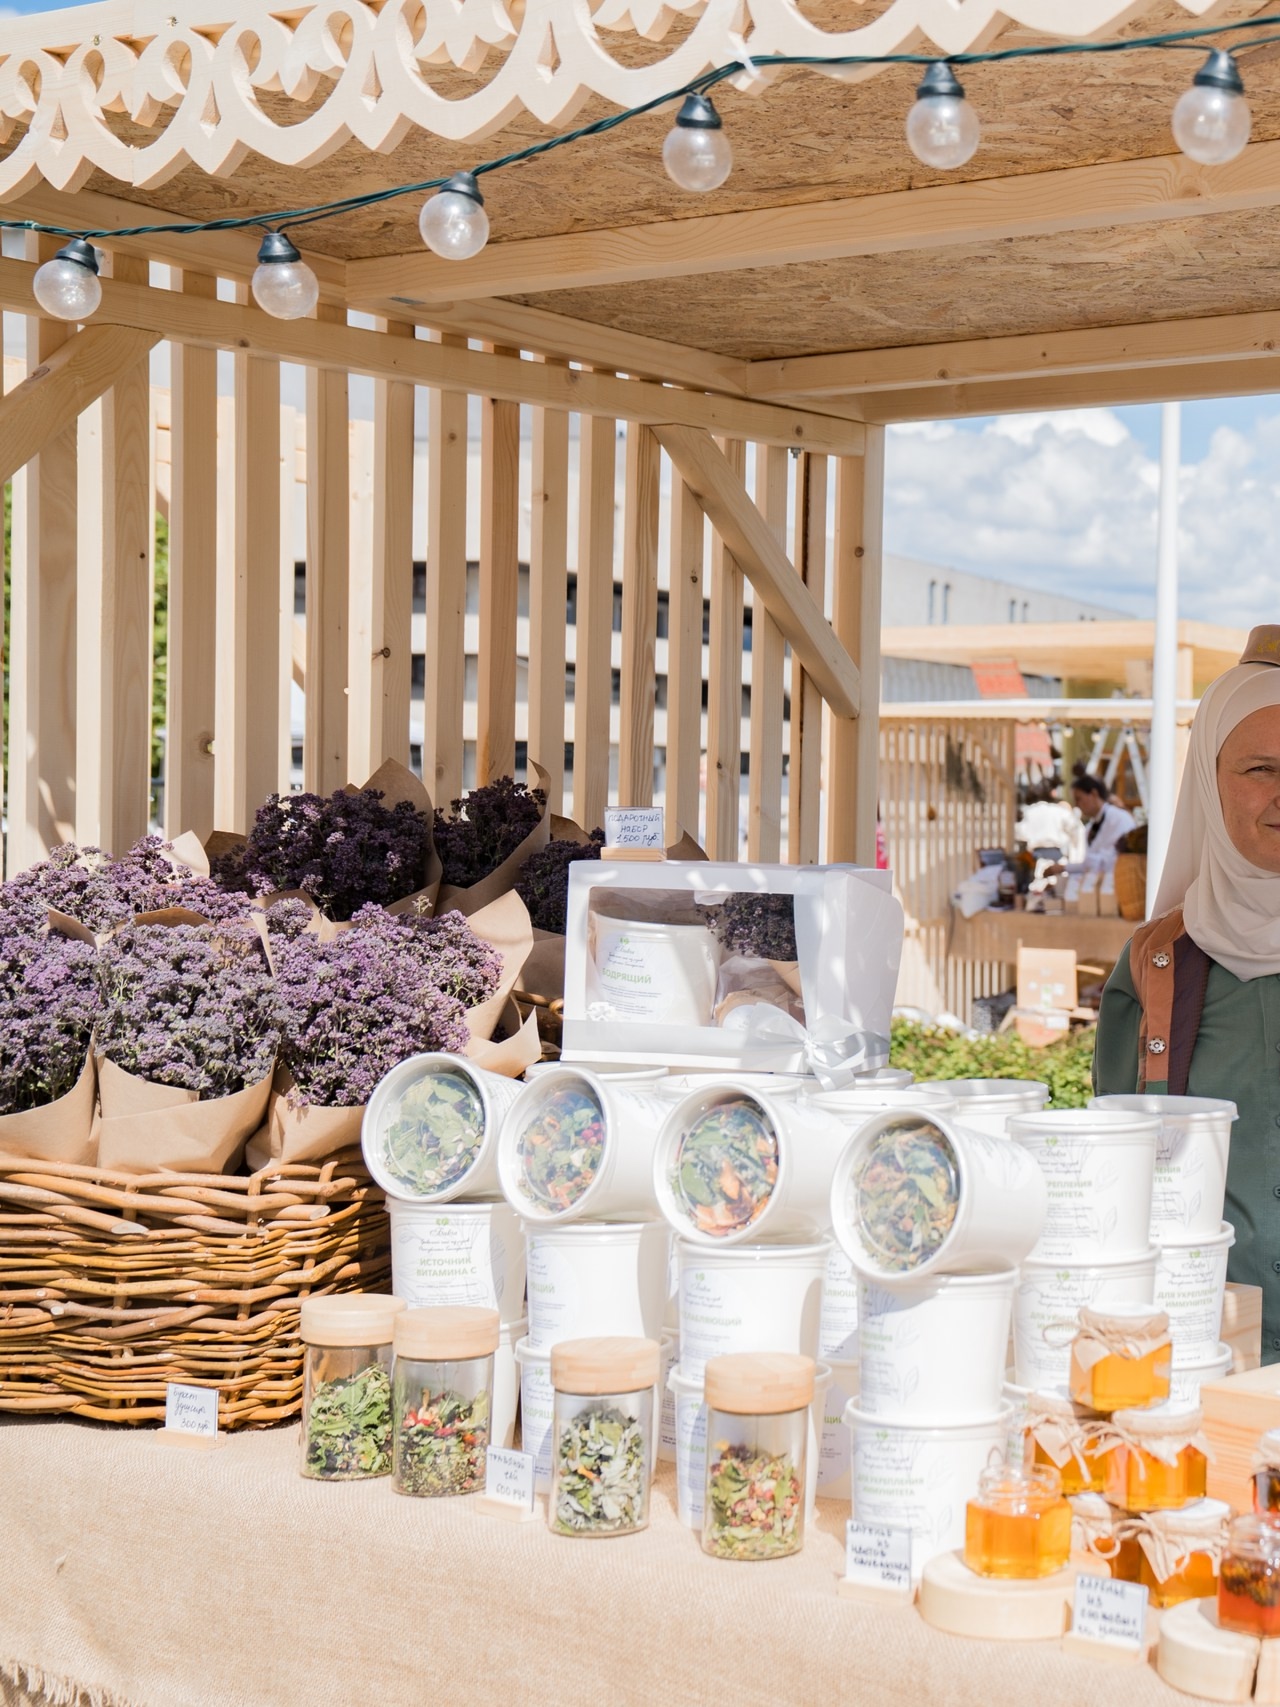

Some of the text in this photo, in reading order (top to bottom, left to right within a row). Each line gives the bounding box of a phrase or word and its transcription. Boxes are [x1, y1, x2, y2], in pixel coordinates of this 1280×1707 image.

[616, 834, 640, 844] 1500
[1047, 1190, 1084, 1198] УНИТЕТА
[419, 1256, 472, 1267] ИСТОЧНИК
[416, 1267, 469, 1278] ВИТАМИНА
